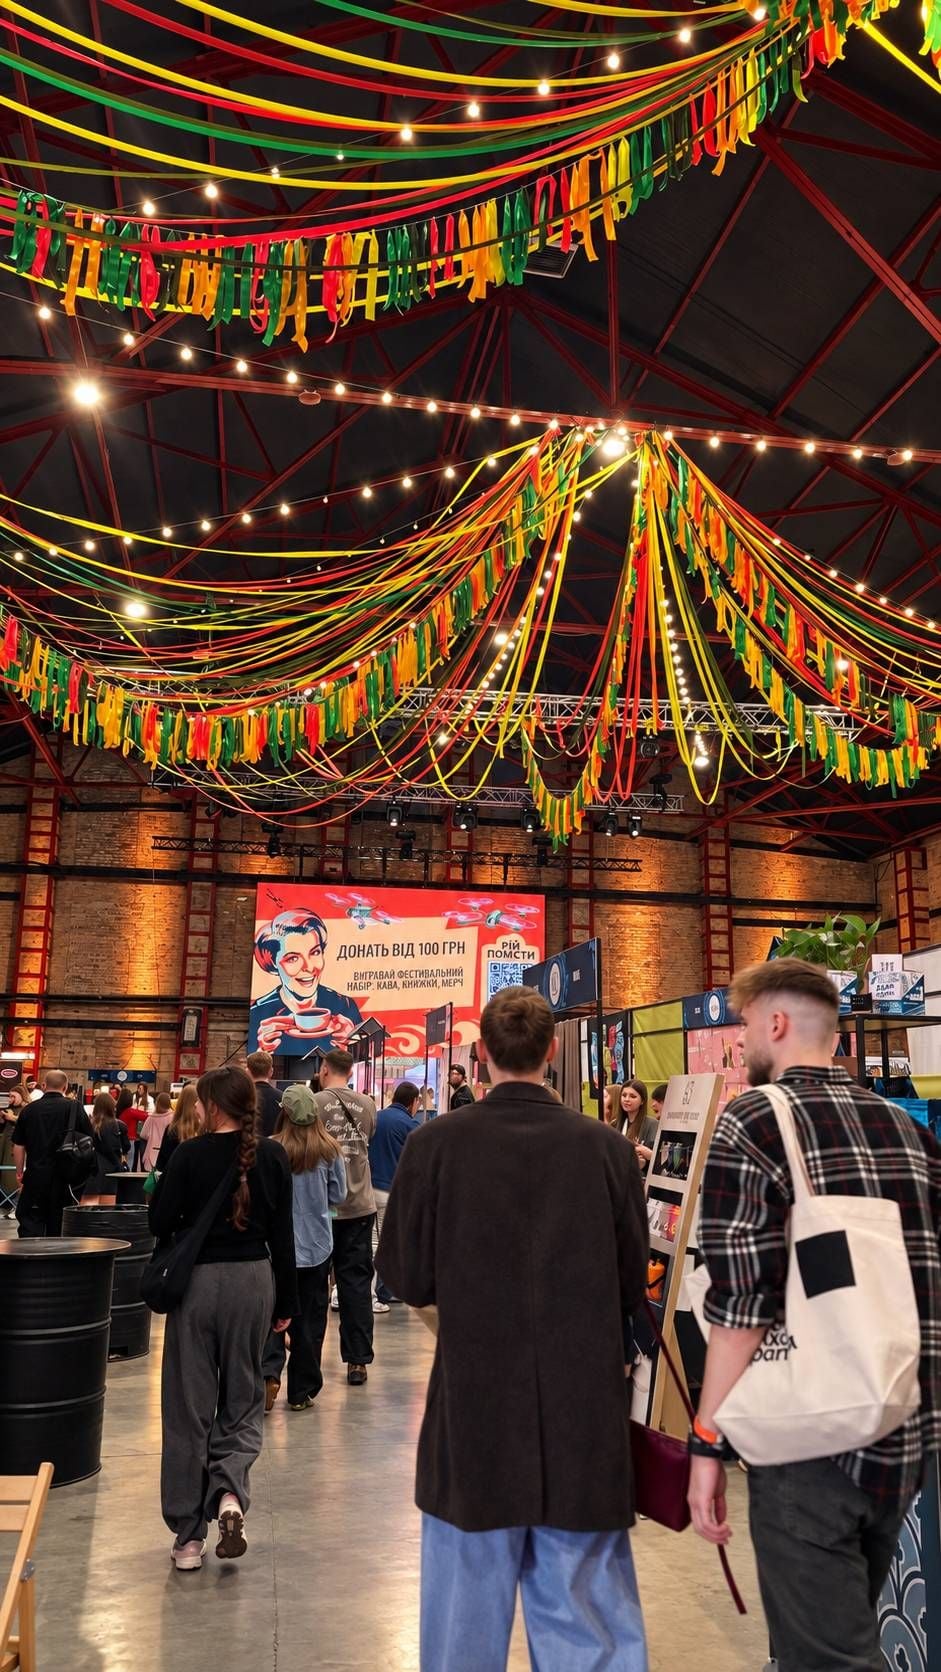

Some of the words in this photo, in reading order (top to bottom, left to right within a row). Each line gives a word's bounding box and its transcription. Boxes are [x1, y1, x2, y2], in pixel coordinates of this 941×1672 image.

[336, 944, 389, 961] ДОНАТЬ
[392, 942, 415, 958] ВІД
[418, 941, 439, 956] 100
[442, 940, 465, 955] ГРН
[487, 949, 535, 960] ПОМСТИ
[353, 969, 396, 981] ВИГРАВАЙ
[397, 966, 464, 979] ФЕСТИВАЛЬНИЙ
[376, 980, 400, 991] КАВА,
[402, 979, 440, 990] КНИЖКИ,
[441, 978, 464, 987] МЕРЧ
